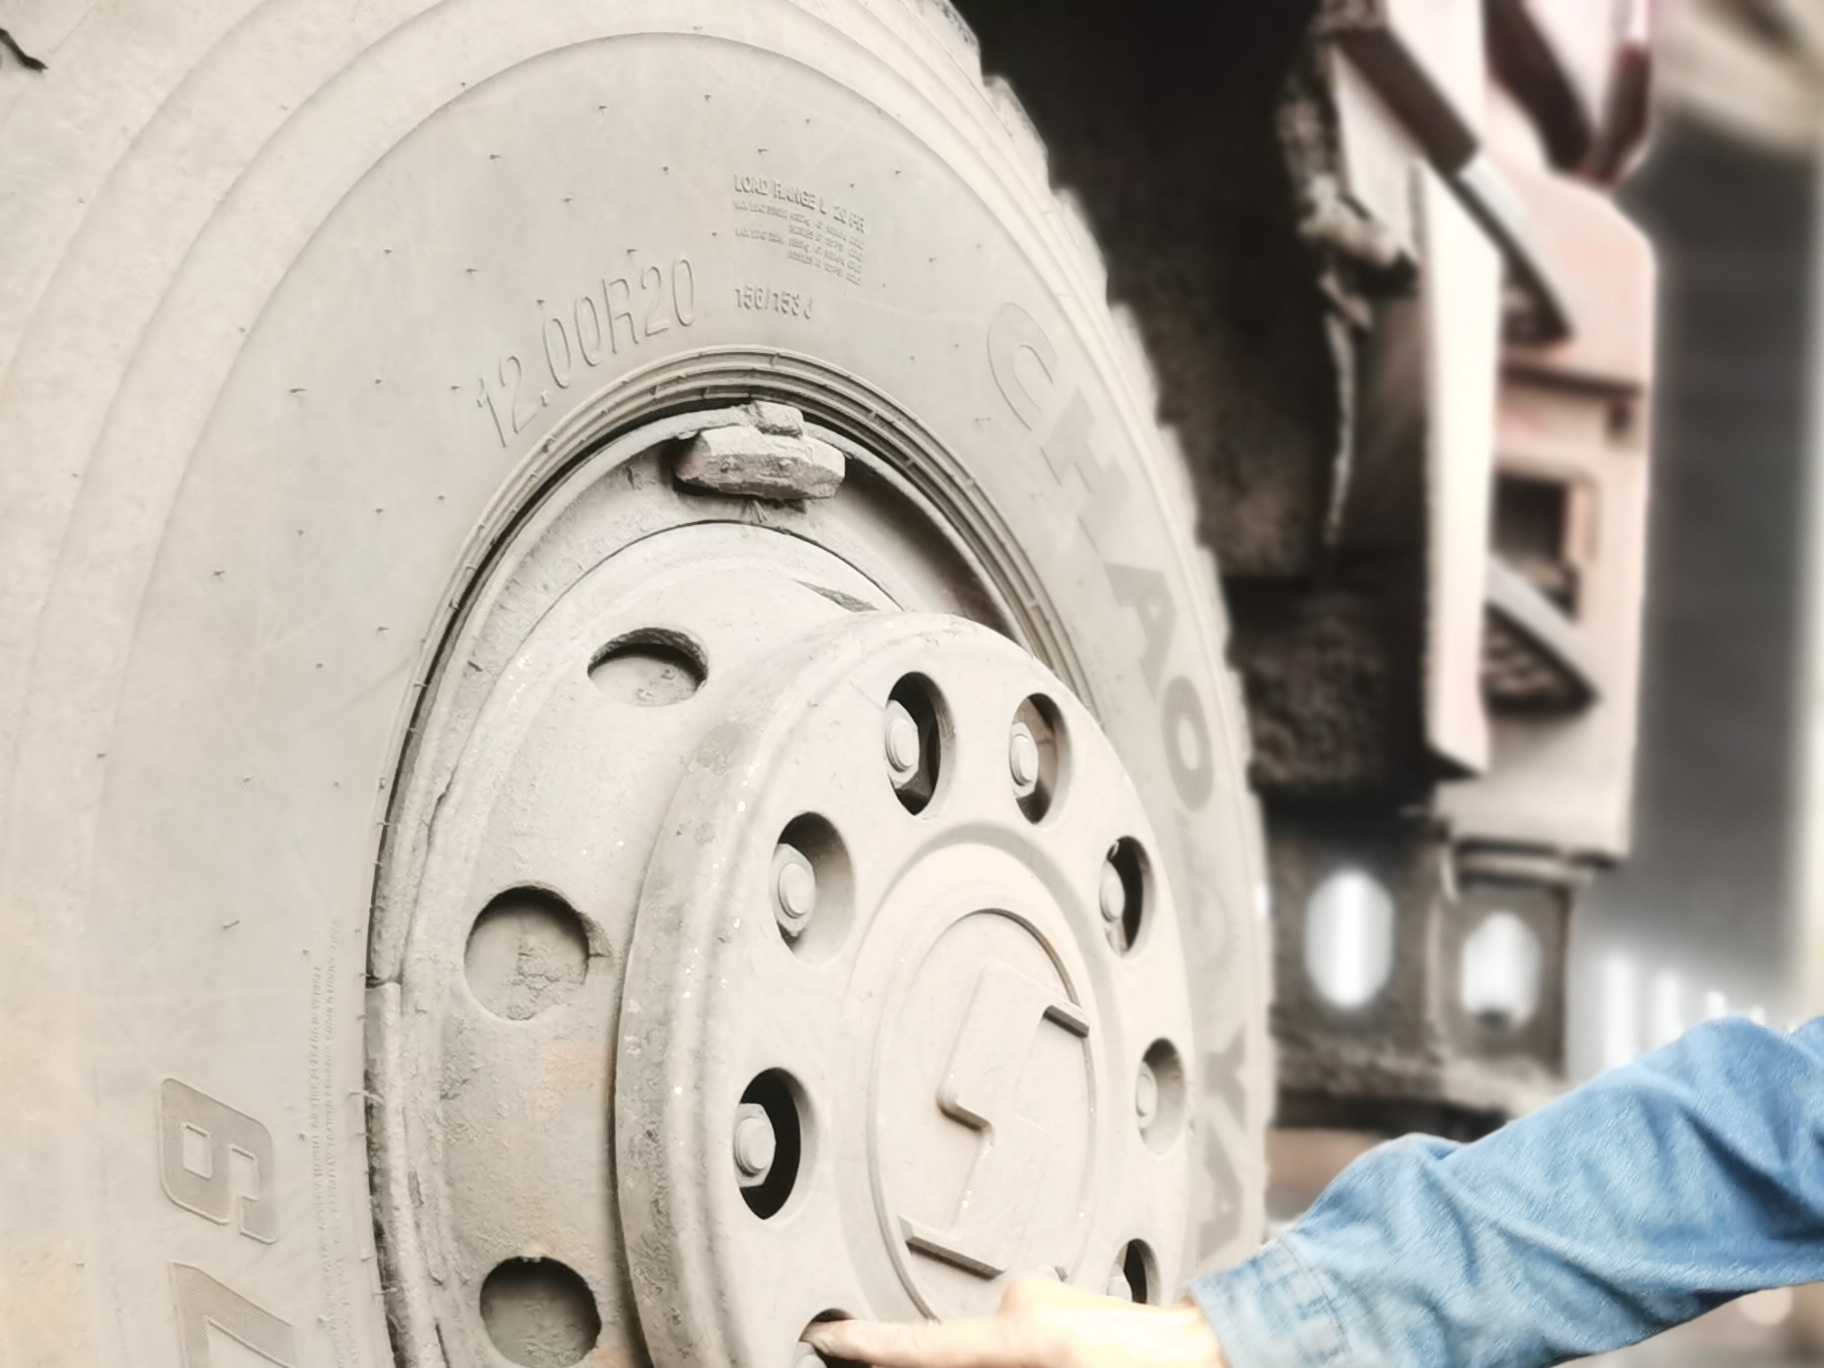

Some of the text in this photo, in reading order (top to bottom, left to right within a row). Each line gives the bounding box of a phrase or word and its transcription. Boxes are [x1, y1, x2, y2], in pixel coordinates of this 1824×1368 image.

[733, 174, 768, 196] LOAD
[773, 179, 816, 210] RANGE
[475, 258, 696, 449] 12.00R20
